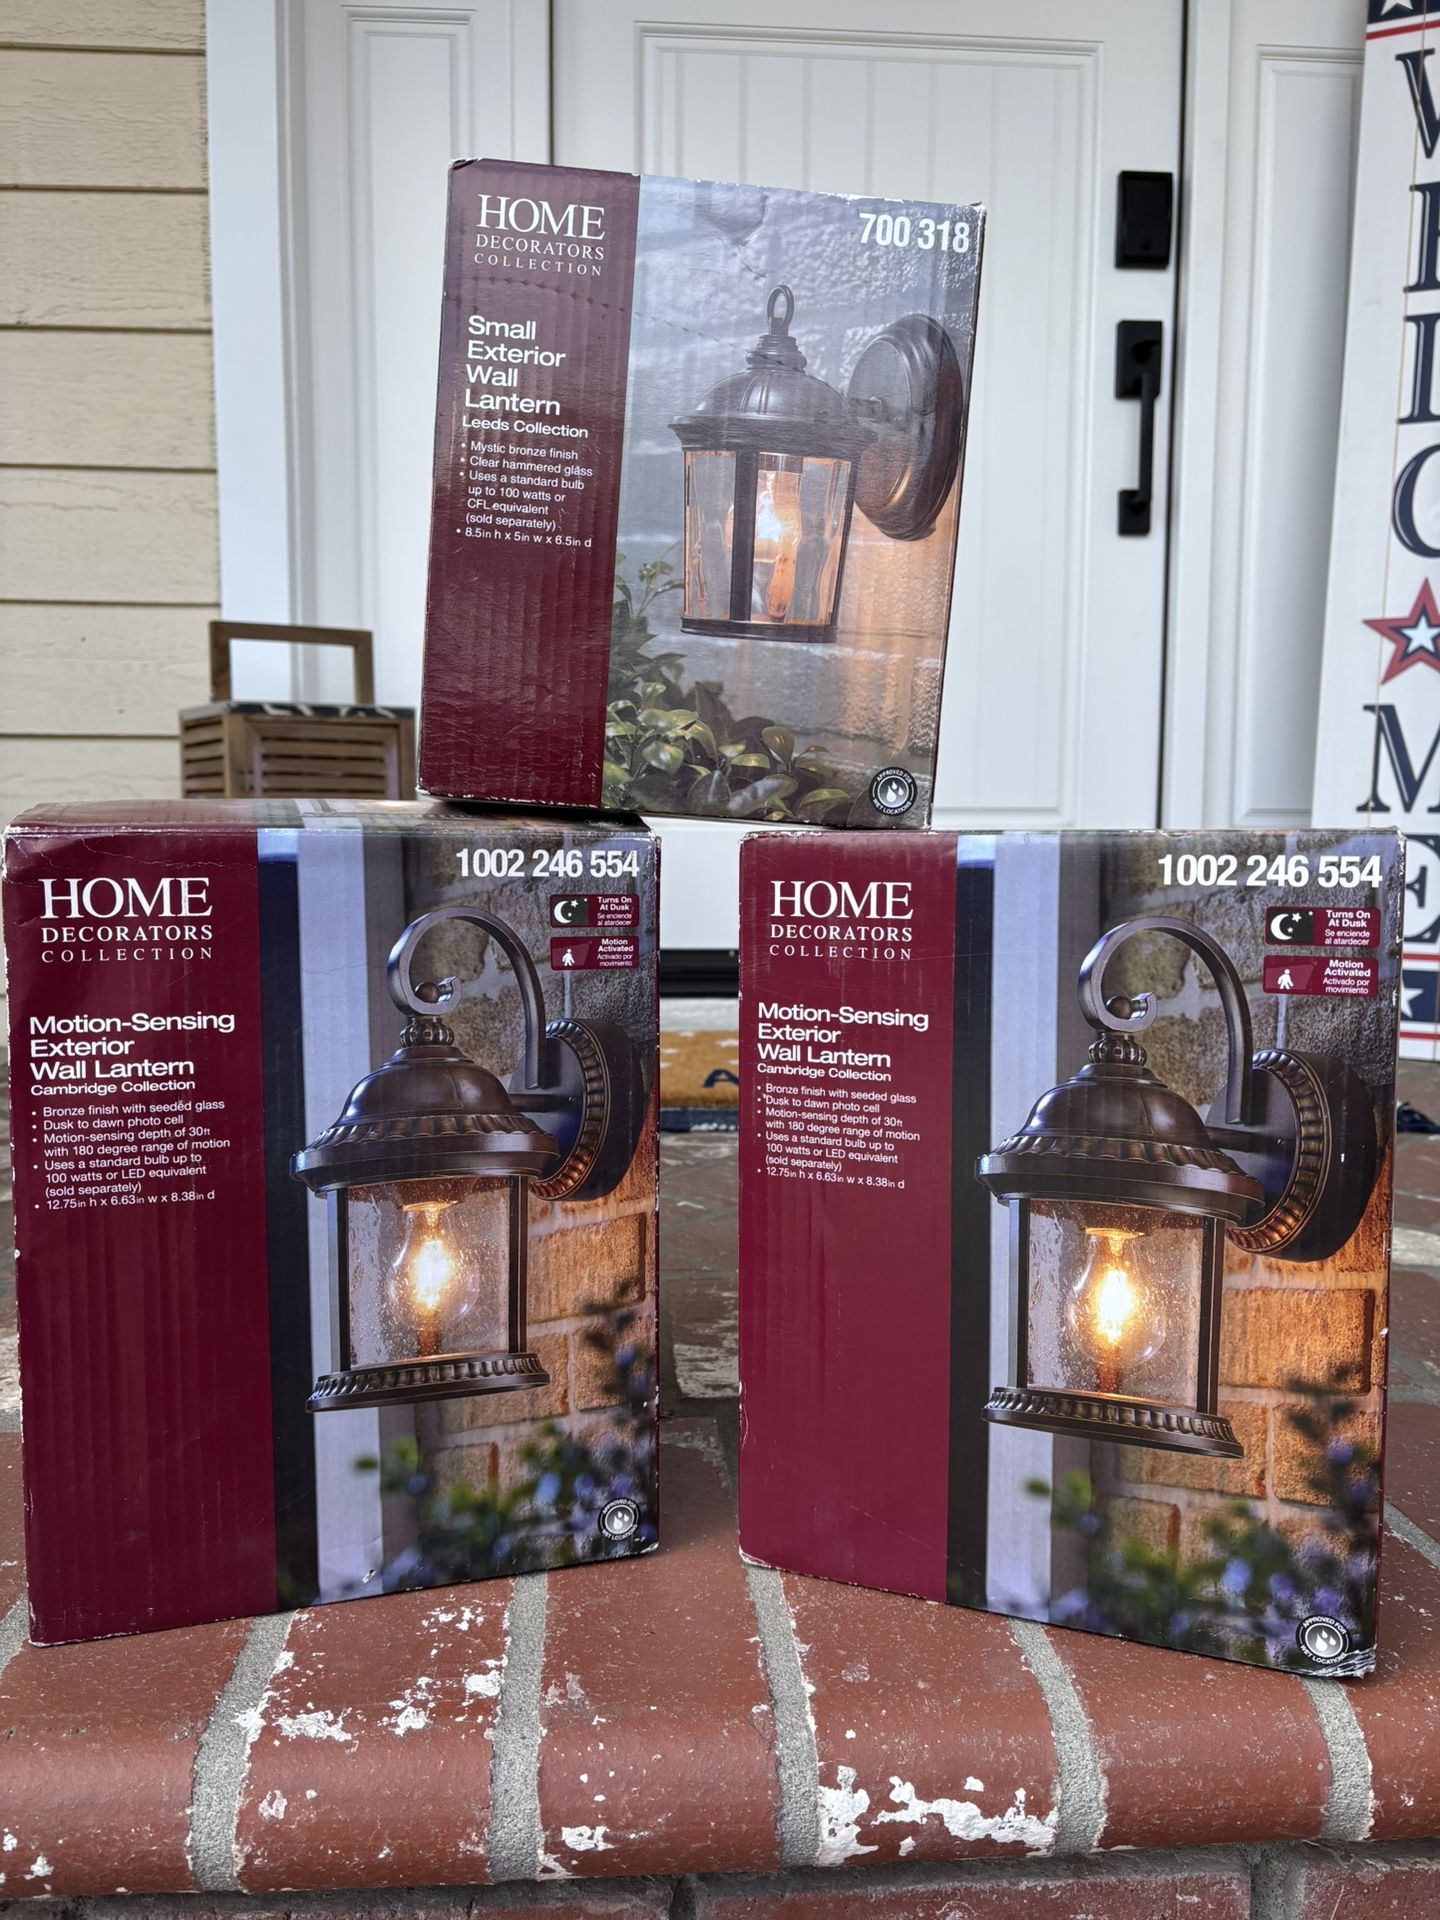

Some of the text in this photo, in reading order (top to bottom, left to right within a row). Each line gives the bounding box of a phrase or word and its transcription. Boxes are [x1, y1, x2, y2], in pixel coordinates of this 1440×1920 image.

[477, 194, 606, 240] HOME
[859, 213, 969, 253] 700 318
[476, 233, 604, 260] DECORATORS
[474, 253, 601, 276] COLLECTION
[468, 315, 536, 340] Small
[468, 340, 566, 367] Exterior
[466, 364, 518, 387] Wall
[465, 388, 561, 415] Lantern
[463, 416, 588, 438] Leeds Collection
[470, 441, 578, 460] Mystic bronze finish
[470, 456, 593, 477] Clear hammered glass
[469, 470, 584, 490] Uses standard bulb
[468, 486, 566, 502] up to 100 watts or
[467, 499, 548, 515] CFL equivalent
[466, 513, 556, 532] (sold separately)
[456, 848, 639, 878] 1002 246 554
[1158, 854, 1383, 888] 1002 246 554
[38, 877, 213, 919] HOME
[770, 880, 914, 920] HOME
[1326, 910, 1370, 918] Turns On
[1342, 919, 1367, 927] Dusk
[41, 924, 213, 944] DECORATORS
[770, 924, 912, 942] DECORATORS
[1336, 929, 1370, 937] enciende
[41, 947, 212, 963] COLLECTION
[769, 944, 911, 960] COLLECTION
[1324, 968, 1371, 977] Activated
[1329, 959, 1364, 968] Motion
[1323, 977, 1355, 985] Activado
[30, 1011, 235, 1035] Motion-Sensing
[758, 1002, 929, 1032] Motion-Sensing
[758, 1023, 841, 1043] Exterior
[30, 1037, 135, 1058] Exterior
[757, 1043, 891, 1067] Wall Lantern
[30, 1059, 194, 1080] Wall Lantern
[757, 1063, 891, 1082] Cambridge Collection
[30, 1081, 196, 1097] Cambridge Collection
[766, 1084, 917, 1104] Bronze finish with seeded glass
[43, 1100, 225, 1117] Bronze finish with seeded glass
[765, 1095, 880, 1113] Dusk to dawn photo cell
[43, 1114, 184, 1130] Dusk to dawn photo cell
[766, 1108, 903, 1127] Motion-sensing depth of 30ft
[43, 1127, 210, 1144] Motion-sensing depth of 30ft
[766, 1120, 920, 1141] with 180 degree range of motion
[44, 1139, 230, 1157] with 180 degree range of motion
[766, 1132, 894, 1151] Uses standard bulb up to
[45, 1154, 202, 1170] Uses standard bulb up to
[765, 1154, 842, 1172] (sold separately)
[766, 1143, 782, 1153] 100
[785, 1145, 811, 1156] watts
[826, 1148, 845, 1159] LED
[848, 1150, 898, 1164] equivalent
[46, 1166, 207, 1183] 100 watts or LED equivalent
[45, 1182, 142, 1198] (sold separately)
[1303, 1616, 1347, 1635] APPROVED FOR
[1300, 1644, 1313, 1657] WET
